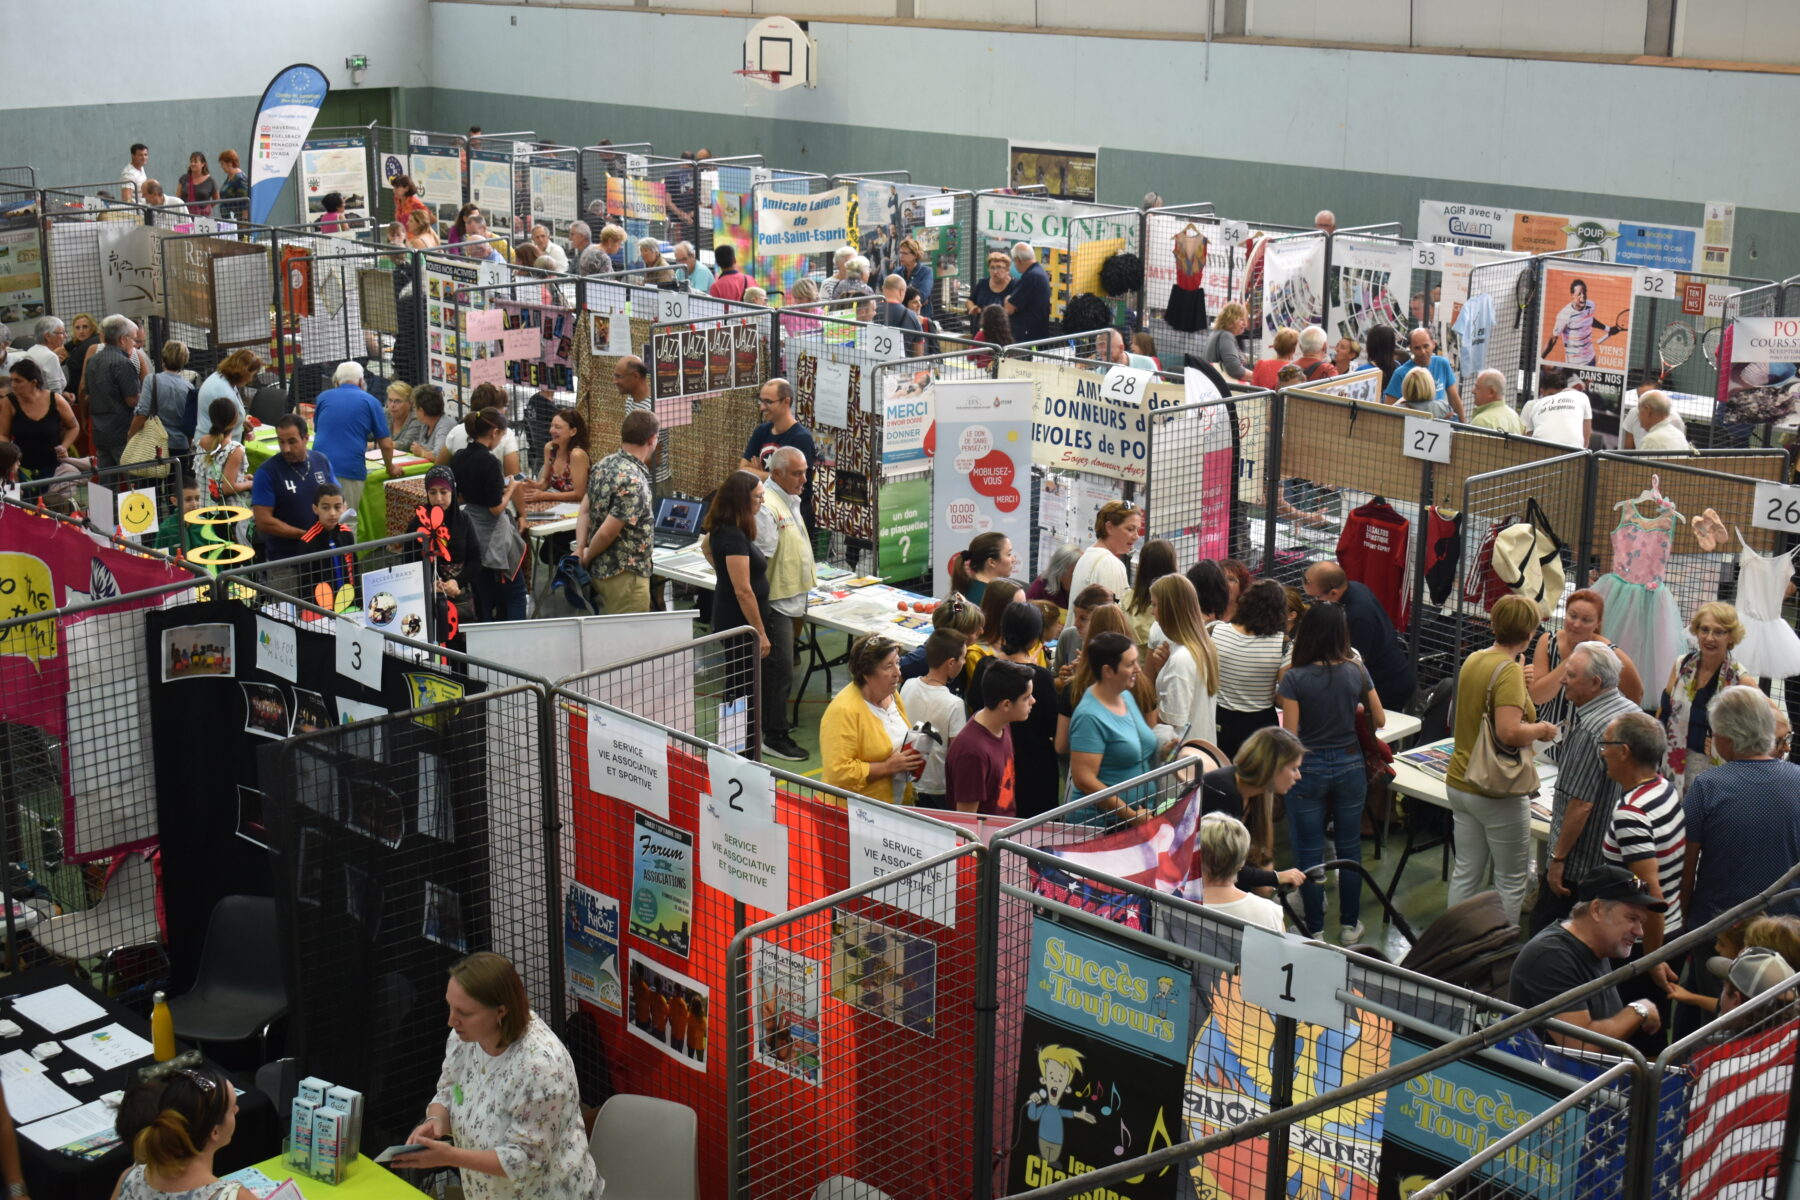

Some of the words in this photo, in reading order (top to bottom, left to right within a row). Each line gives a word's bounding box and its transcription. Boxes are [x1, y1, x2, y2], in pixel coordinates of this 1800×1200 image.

[762, 196, 807, 212] Amicale
[1444, 206, 1466, 215] AGIR
[1469, 208, 1490, 218] avec
[1493, 211, 1501, 221] la
[794, 216, 807, 227] de
[987, 209, 1033, 234] LES
[759, 227, 846, 245] Pont-Saint-Esprit
[1224, 227, 1240, 241] 54
[1578, 227, 1604, 238] POUR
[1419, 250, 1435, 265] 53
[488, 271, 500, 285] 31
[1644, 276, 1664, 292] 52
[1689, 289, 1699, 297] TEN
[665, 301, 682, 318] 30
[1688, 300, 1698, 308] NIS
[735, 326, 757, 349] JAZZ
[1774, 320, 1800, 337] PO
[657, 334, 680, 359] JAZZ
[683, 331, 706, 356] JAZZ
[709, 327, 732, 352] JAZZ
[874, 336, 892, 355] 29
[1599, 345, 1624, 356] VIENS
[1597, 357, 1623, 368] JOUER
[1111, 375, 1136, 395] 28
[1580, 370, 1602, 382] DANS
[1604, 373, 1622, 384] NOS
[1588, 382, 1616, 394] CLUBS
[887, 402, 928, 420] MERCI
[1045, 396, 1127, 431] DONNEURS
[887, 429, 920, 440] DONNER
[1414, 430, 1439, 453] 27
[1098, 437, 1114, 455] de
[973, 467, 1012, 477] MOBILISEZ-
[1061, 451, 1089, 467] Soyez
[1090, 457, 1121, 471] donneur
[1124, 463, 1145, 477] Ayez
[285, 480, 297, 494] 4
[983, 476, 1002, 485] VOUS
[997, 496, 1015, 504] MERCI
[893, 513, 902, 521] un
[904, 509, 917, 519] don
[952, 514, 973, 524] DONS
[1767, 498, 1800, 524] 26
[880, 527, 889, 536] de
[890, 520, 928, 536] plaquettes
[899, 535, 911, 563] ?
[372, 574, 394, 583] ACCESS
[351, 641, 362, 671] 3
[613, 739, 644, 758] SERVICE
[598, 749, 610, 760] VIE
[612, 753, 658, 778] ASSOCIATIVE
[606, 766, 616, 775] ET
[618, 770, 652, 790] SPORTIVE
[728, 777, 744, 813] 2
[640, 834, 685, 860] Forum
[724, 833, 757, 854] SERVICE
[882, 838, 922, 859] SERVICE
[712, 841, 723, 853] VIE
[723, 848, 776, 875] ASSOCIATIVE
[864, 847, 878, 860] VIE
[881, 854, 941, 881] ASSOTIVE
[643, 869, 686, 890] ASSOCIATIONS
[718, 859, 727, 869] ET
[728, 863, 767, 887] SPORTIVE
[873, 867, 885, 877] ET
[888, 872, 933, 895] ORTIVE
[1044, 937, 1149, 1004] Succès
[1279, 963, 1296, 1002] 1
[1039, 979, 1051, 992] de
[1050, 972, 1175, 1043] Toujours
[1404, 1070, 1534, 1132] Succès
[1400, 1102, 1416, 1118] de
[1412, 1097, 1561, 1187] Toujours
